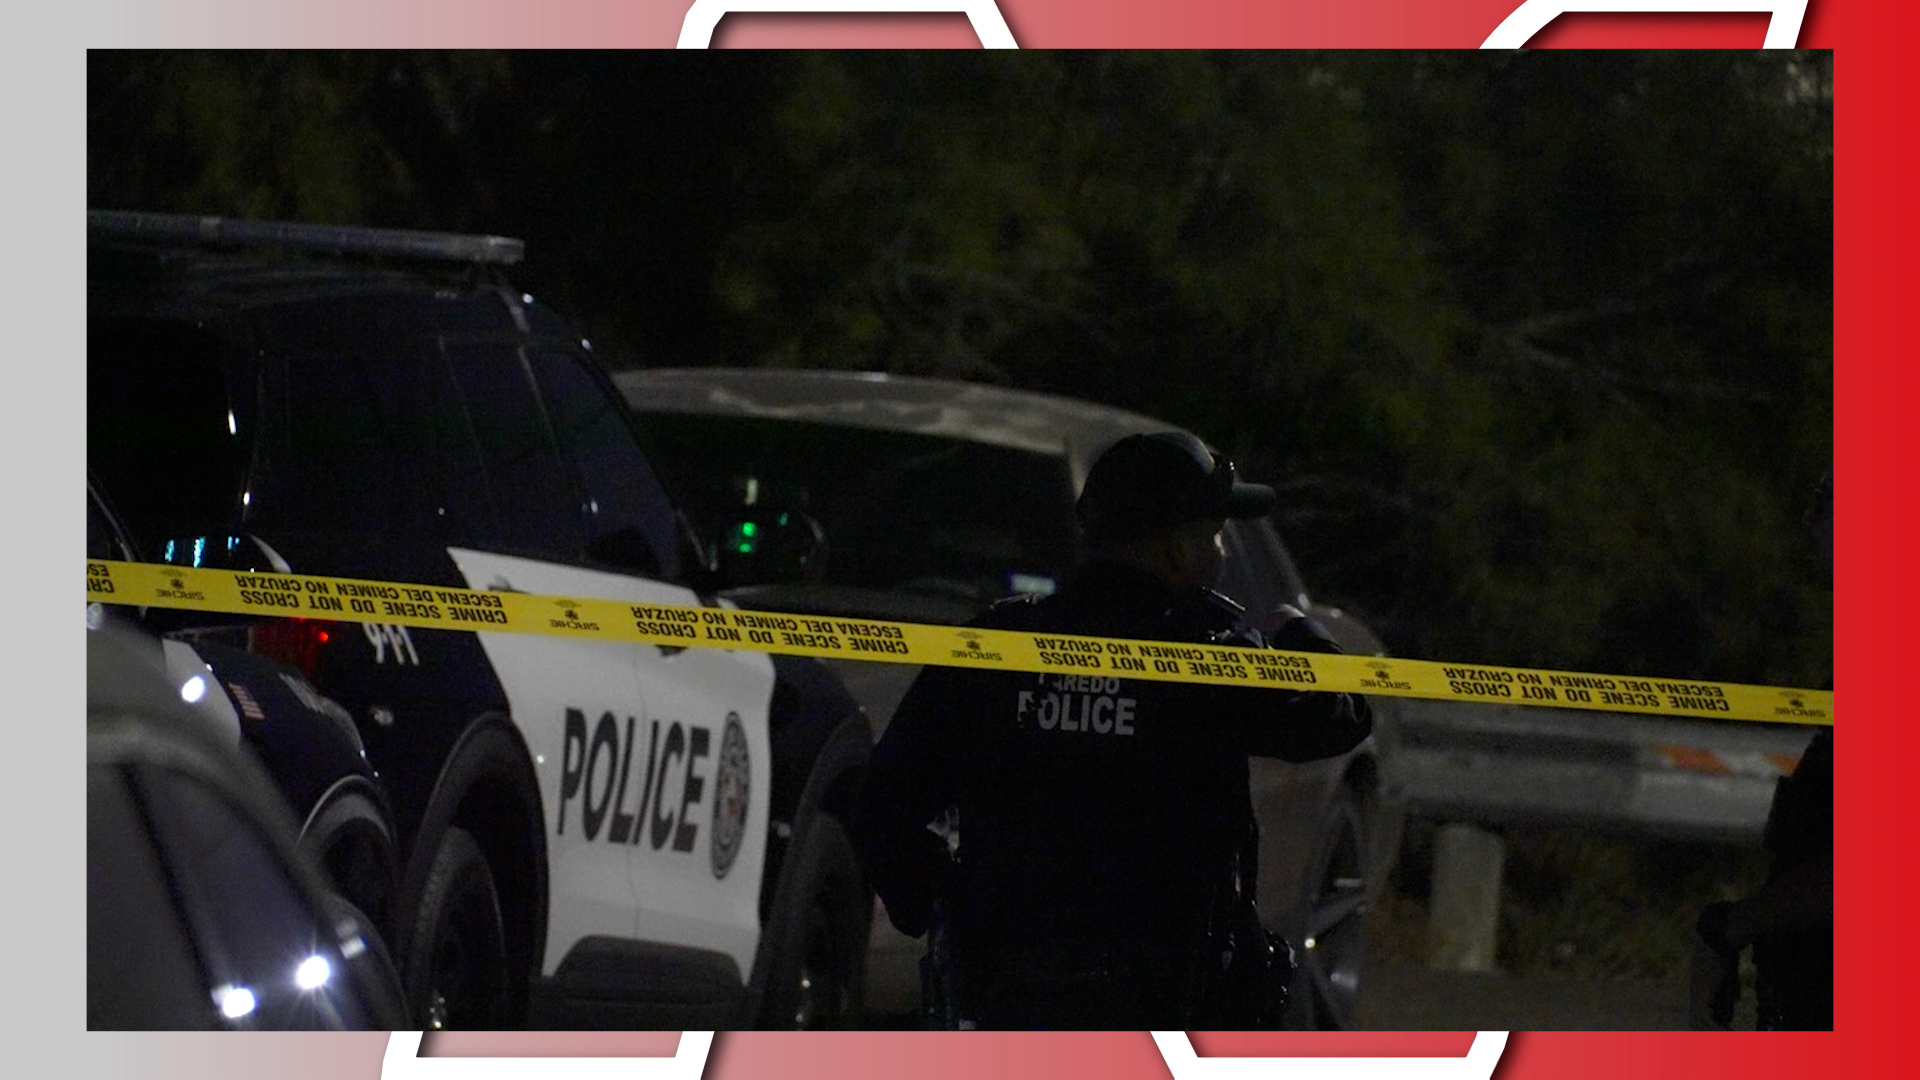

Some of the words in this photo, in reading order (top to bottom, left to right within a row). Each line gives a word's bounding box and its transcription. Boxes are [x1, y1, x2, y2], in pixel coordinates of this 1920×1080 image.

[87, 563, 109, 576] ES
[235, 574, 301, 591] CRUZAR
[306, 580, 329, 594] NO
[241, 590, 299, 608] CROSS
[336, 583, 399, 599] CRIMEN
[401, 588, 434, 601] DEL
[436, 590, 503, 608] ESCENA
[309, 595, 343, 611] NOT
[352, 599, 376, 614] DO
[384, 601, 441, 619] SCENE
[450, 607, 508, 624] CRIME
[630, 606, 698, 623] CRUZAR
[702, 612, 726, 625] NO
[733, 614, 798, 631] CRIMEN
[549, 619, 600, 631] SIRCHIE
[636, 621, 697, 638] CROSS
[801, 619, 834, 633] DEL
[836, 622, 903, 639] ESCENA
[706, 627, 742, 642] NOT
[749, 630, 774, 644] DO
[781, 632, 841, 649] SCENE
[848, 637, 909, 654] CRIME
[1033, 637, 1103, 654] CRUZAR
[1106, 642, 1132, 655] NO
[1138, 645, 1204, 661] CRIMEN
[951, 650, 1003, 661] SIRCHIE
[1039, 651, 1101, 668] CROSS
[1207, 650, 1240, 663] DEL
[1243, 652, 1311, 669] ESCENA
[1111, 656, 1146, 672] NOT
[1154, 659, 1180, 674] DO
[1188, 662, 1248, 678] SCENE
[1256, 667, 1317, 684] CRIME
[1442, 667, 1513, 683] CRUZAR
[1517, 673, 1542, 685] NO
[1549, 675, 1616, 690] CRIMEN
[1359, 678, 1411, 690] SIRCHIE
[1449, 680, 1511, 697] CROSS
[1618, 680, 1650, 692] DEL
[1652, 682, 1724, 698] ESCENA
[1521, 685, 1558, 701] NOT
[1564, 688, 1592, 702] DO
[1598, 690, 1660, 707] SCENE
[1668, 695, 1730, 711] CRIME
[1017, 690, 1137, 735] POLICE
[557, 707, 710, 853] POLICE
